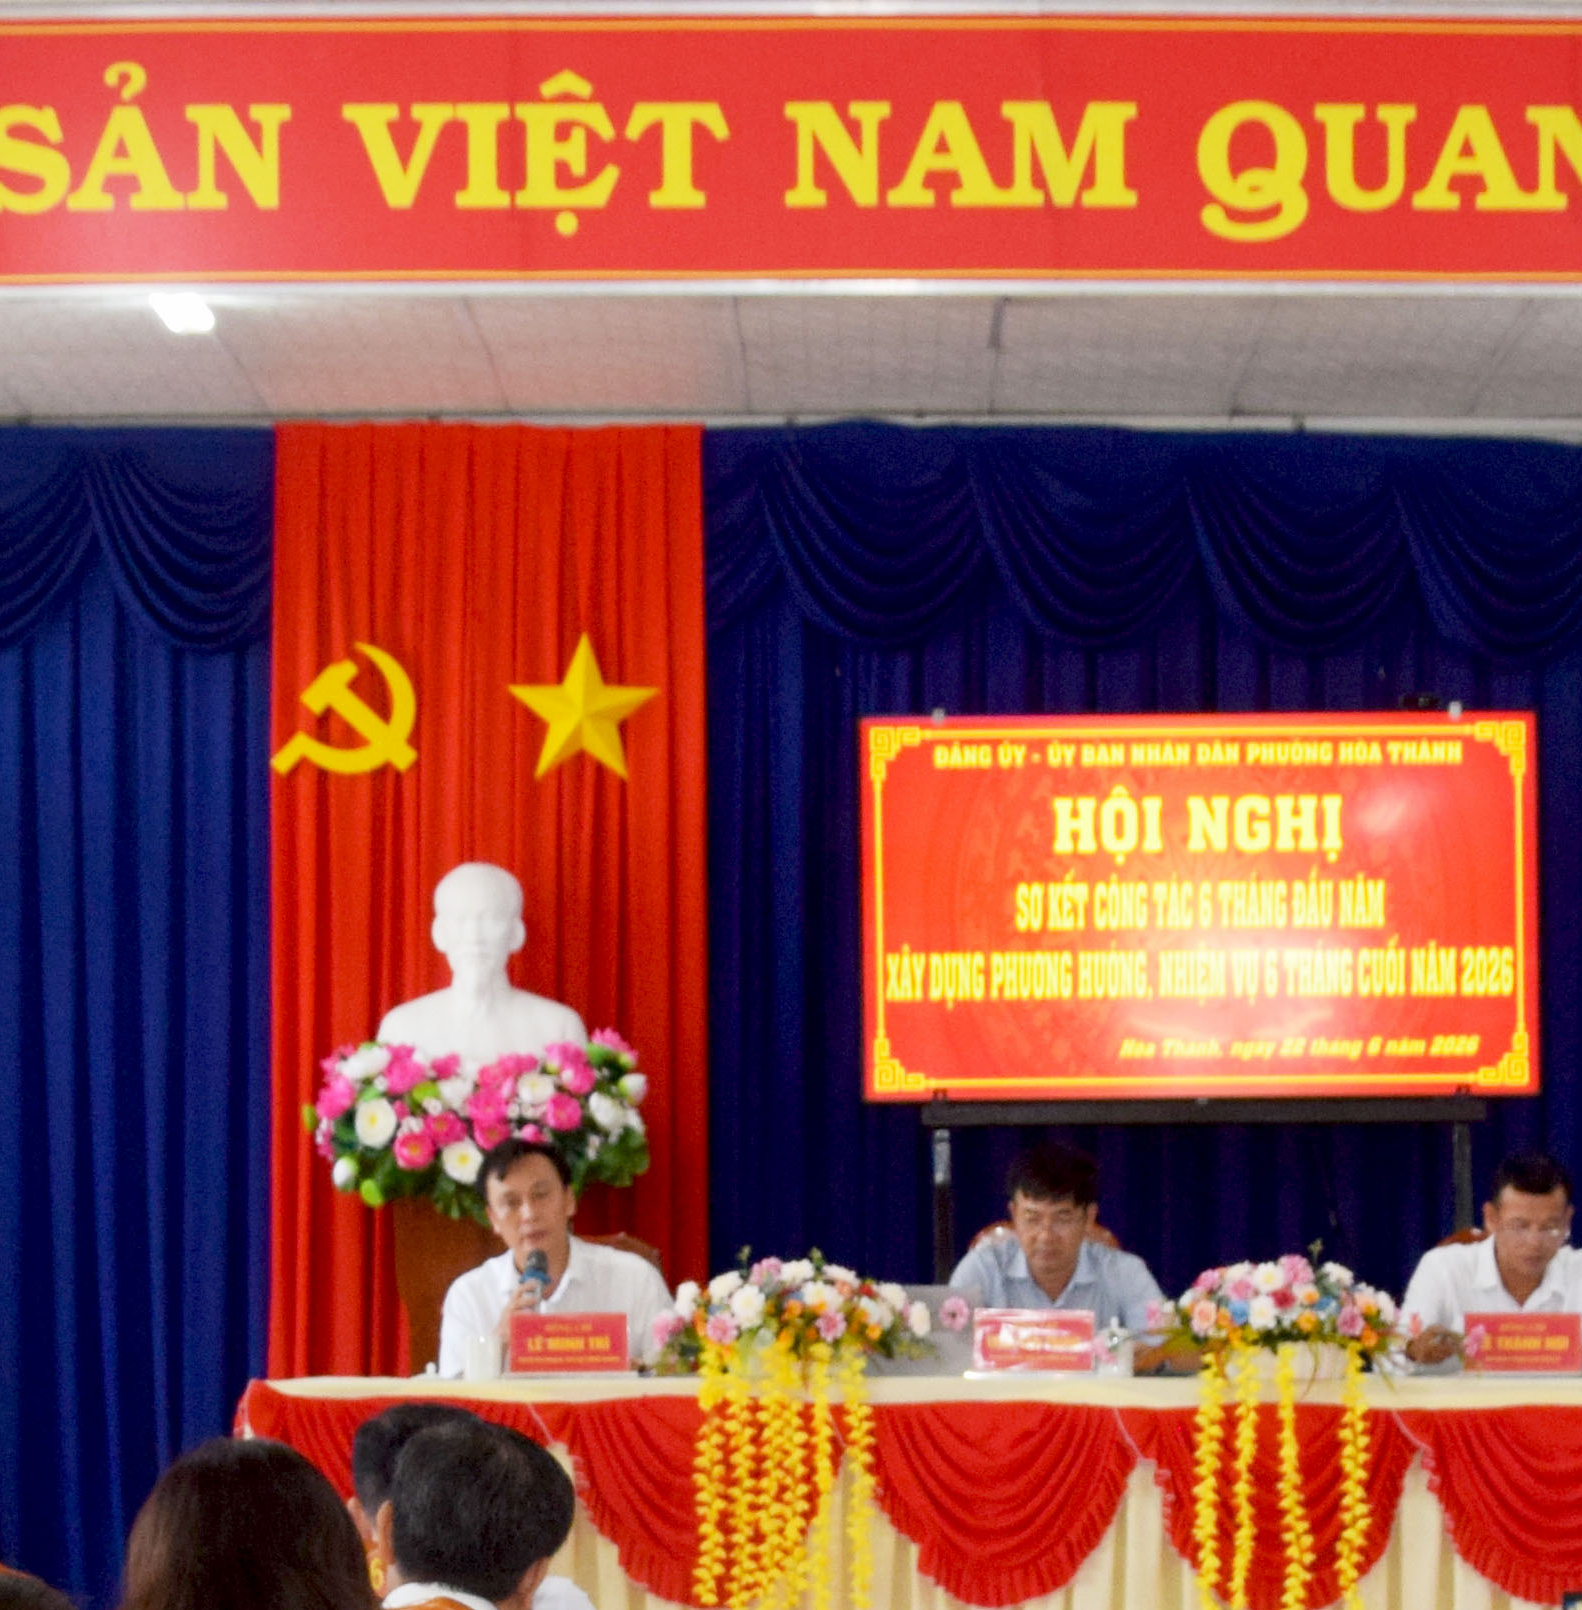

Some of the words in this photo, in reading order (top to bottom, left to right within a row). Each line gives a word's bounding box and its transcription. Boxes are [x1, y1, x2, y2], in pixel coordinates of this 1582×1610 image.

[342, 70, 729, 235] VIỆT
[785, 101, 1137, 209] NAM
[1081, 744, 1125, 767] BAN
[1130, 741, 1191, 767] NHÂN
[1196, 741, 1240, 766] DÂN
[1053, 784, 1164, 865] HỘI
[1187, 795, 1342, 862] NGHỊ
[1093, 871, 1148, 931] CÔNG
[1152, 871, 1194, 929] TÁC
[1198, 881, 1212, 930] 6
[1217, 871, 1287, 929] THÁNG
[886, 943, 926, 1001] XÂY
[1357, 933, 1406, 997] CUỐI
[1410, 939, 1456, 997] NĂM
[1460, 946, 1514, 997] 2026
